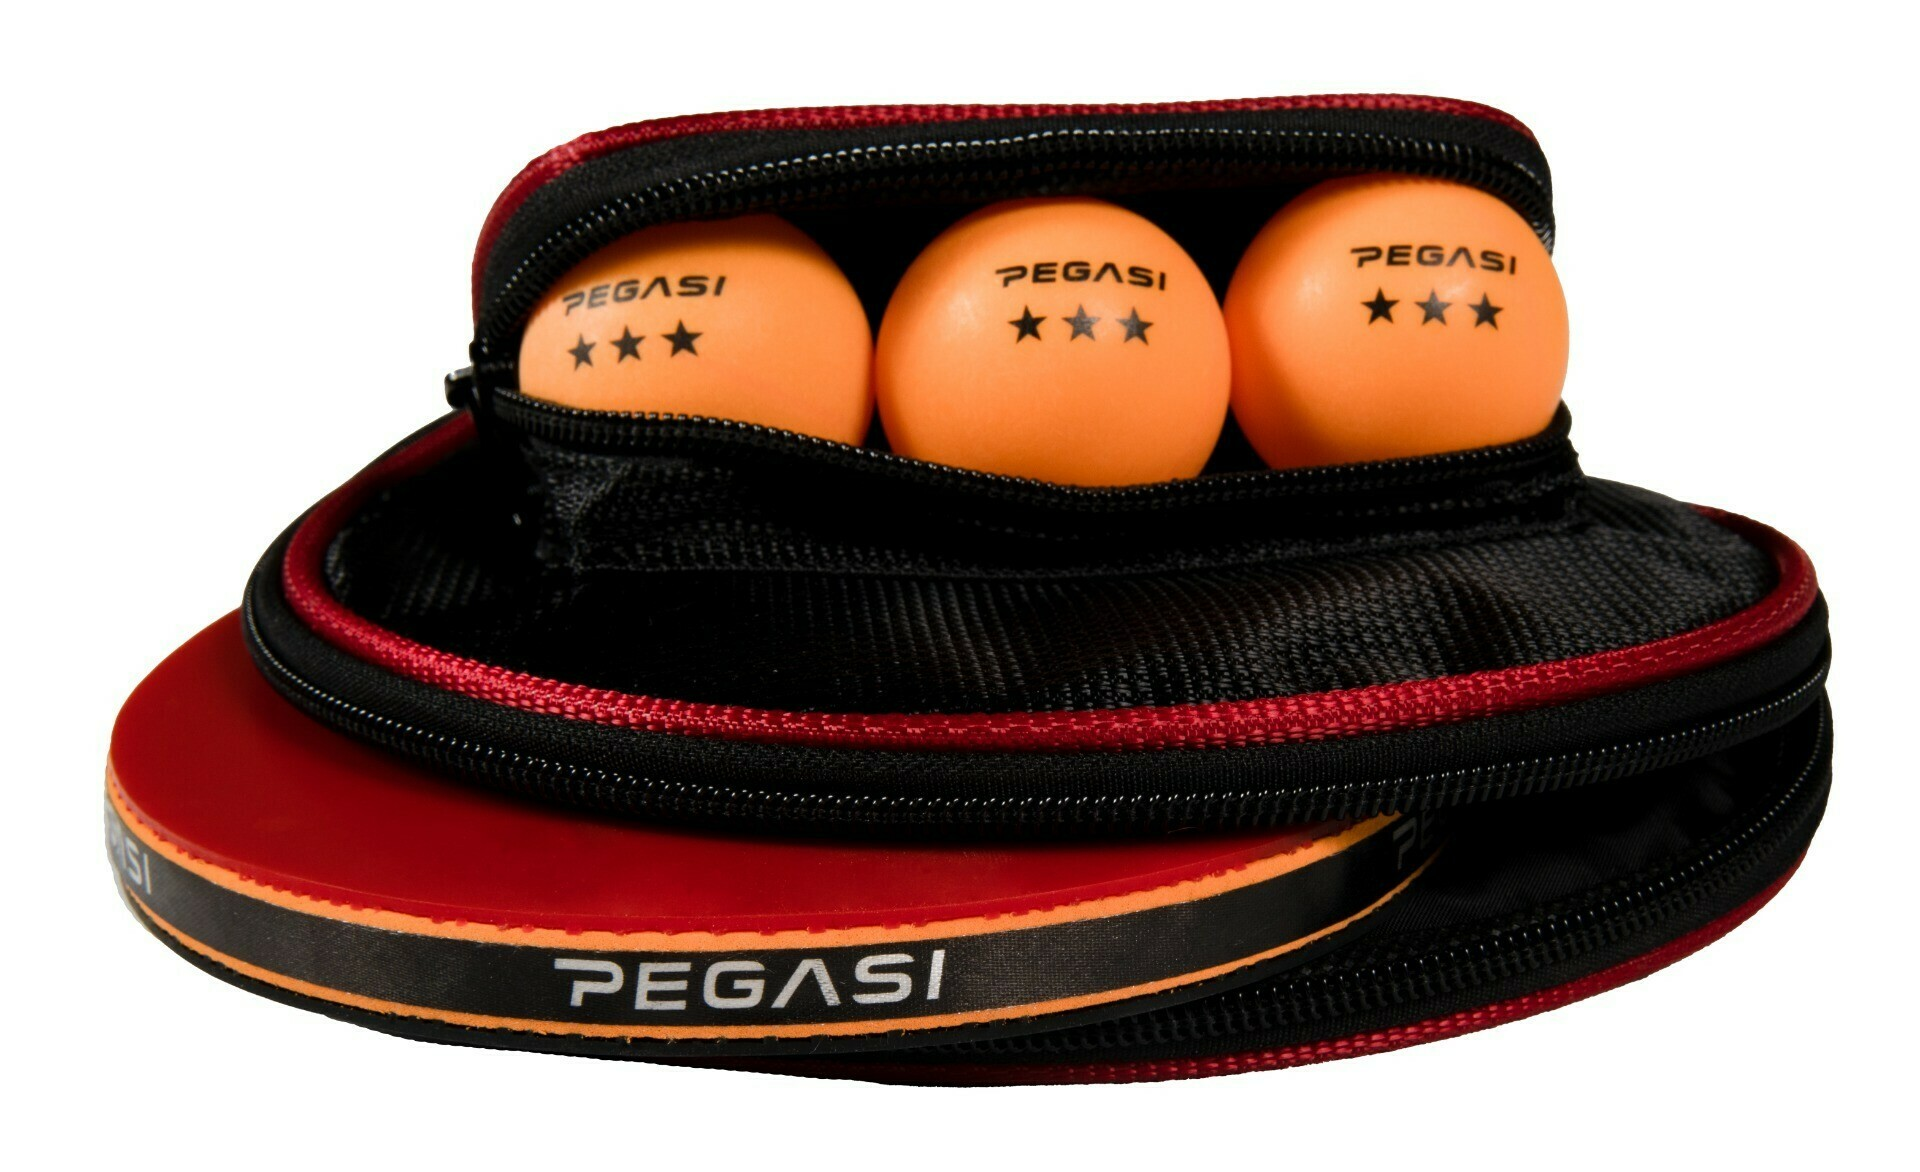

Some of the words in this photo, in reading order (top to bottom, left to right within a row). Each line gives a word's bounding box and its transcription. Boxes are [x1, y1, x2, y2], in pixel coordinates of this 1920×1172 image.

[995, 261, 1166, 291] PEGASI
[1350, 245, 1516, 275] PEGASI
[563, 275, 726, 316] PEGASI
[554, 949, 946, 1011] PEGASI
